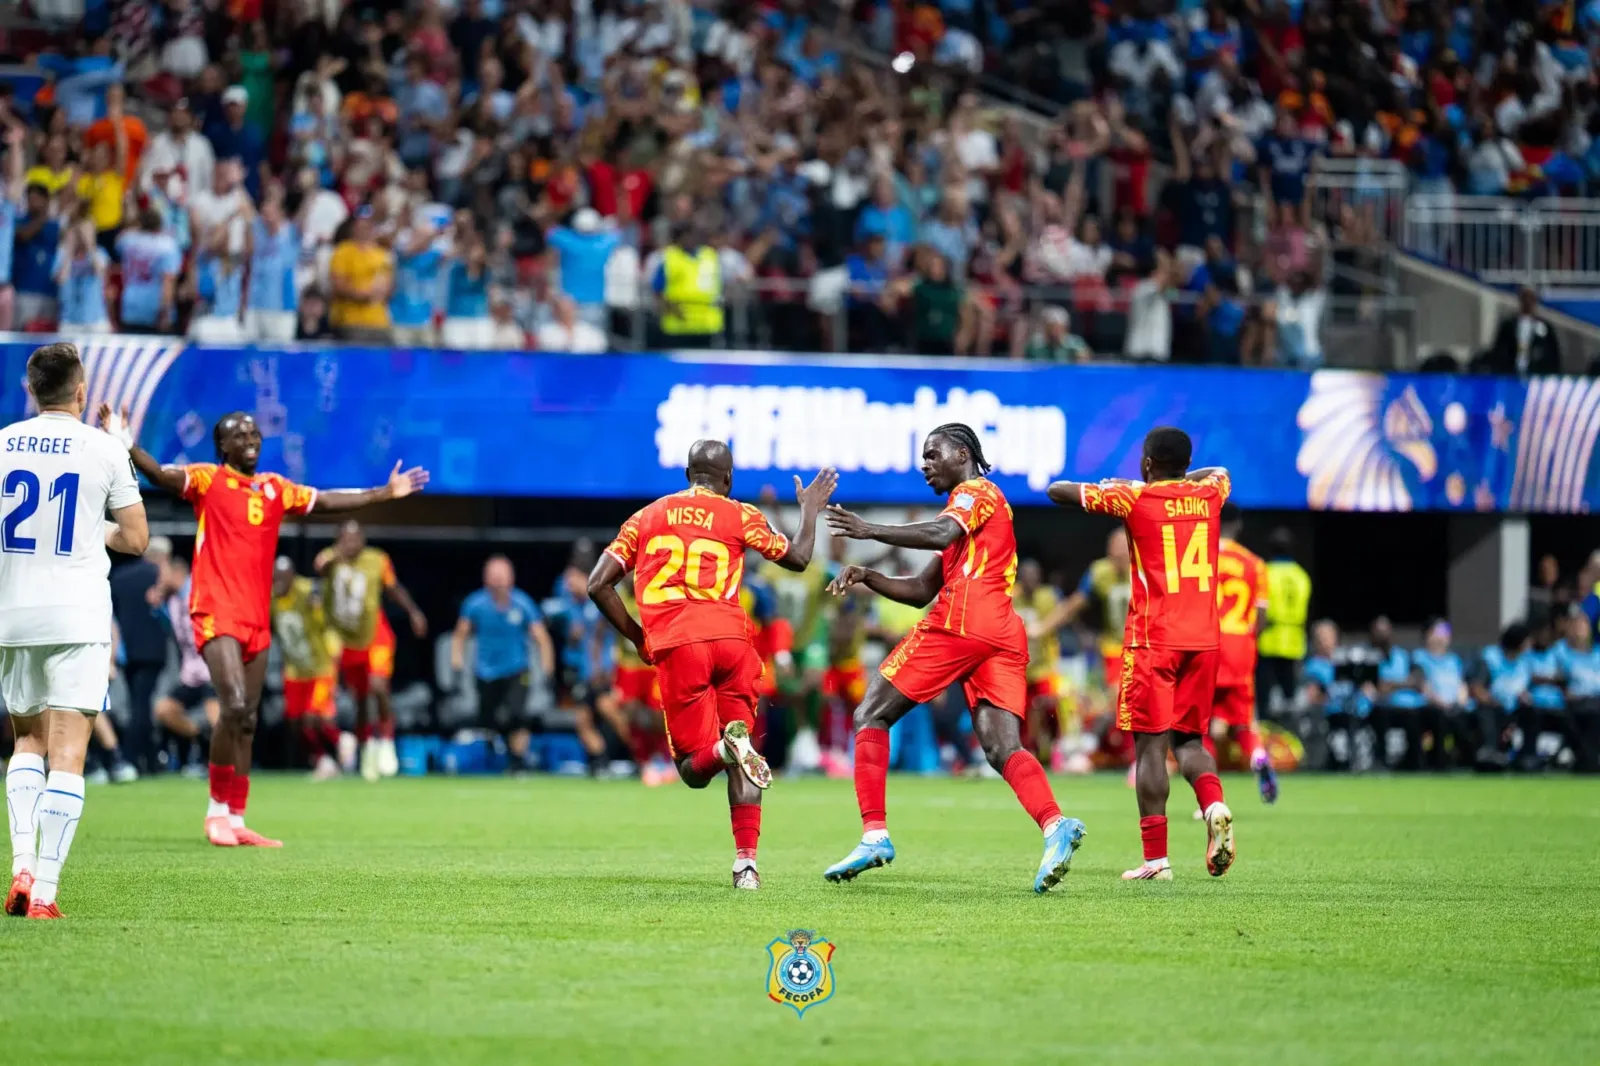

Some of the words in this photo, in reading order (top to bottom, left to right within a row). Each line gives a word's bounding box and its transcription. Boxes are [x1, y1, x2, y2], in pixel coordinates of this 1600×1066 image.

[6, 436, 72, 454] SERGEE
[1, 469, 80, 556] 21
[247, 497, 264, 526] 6
[666, 506, 714, 531] WISSA
[1164, 496, 1210, 518] SADIKI
[642, 534, 730, 605] 20
[1161, 522, 1213, 594] 14
